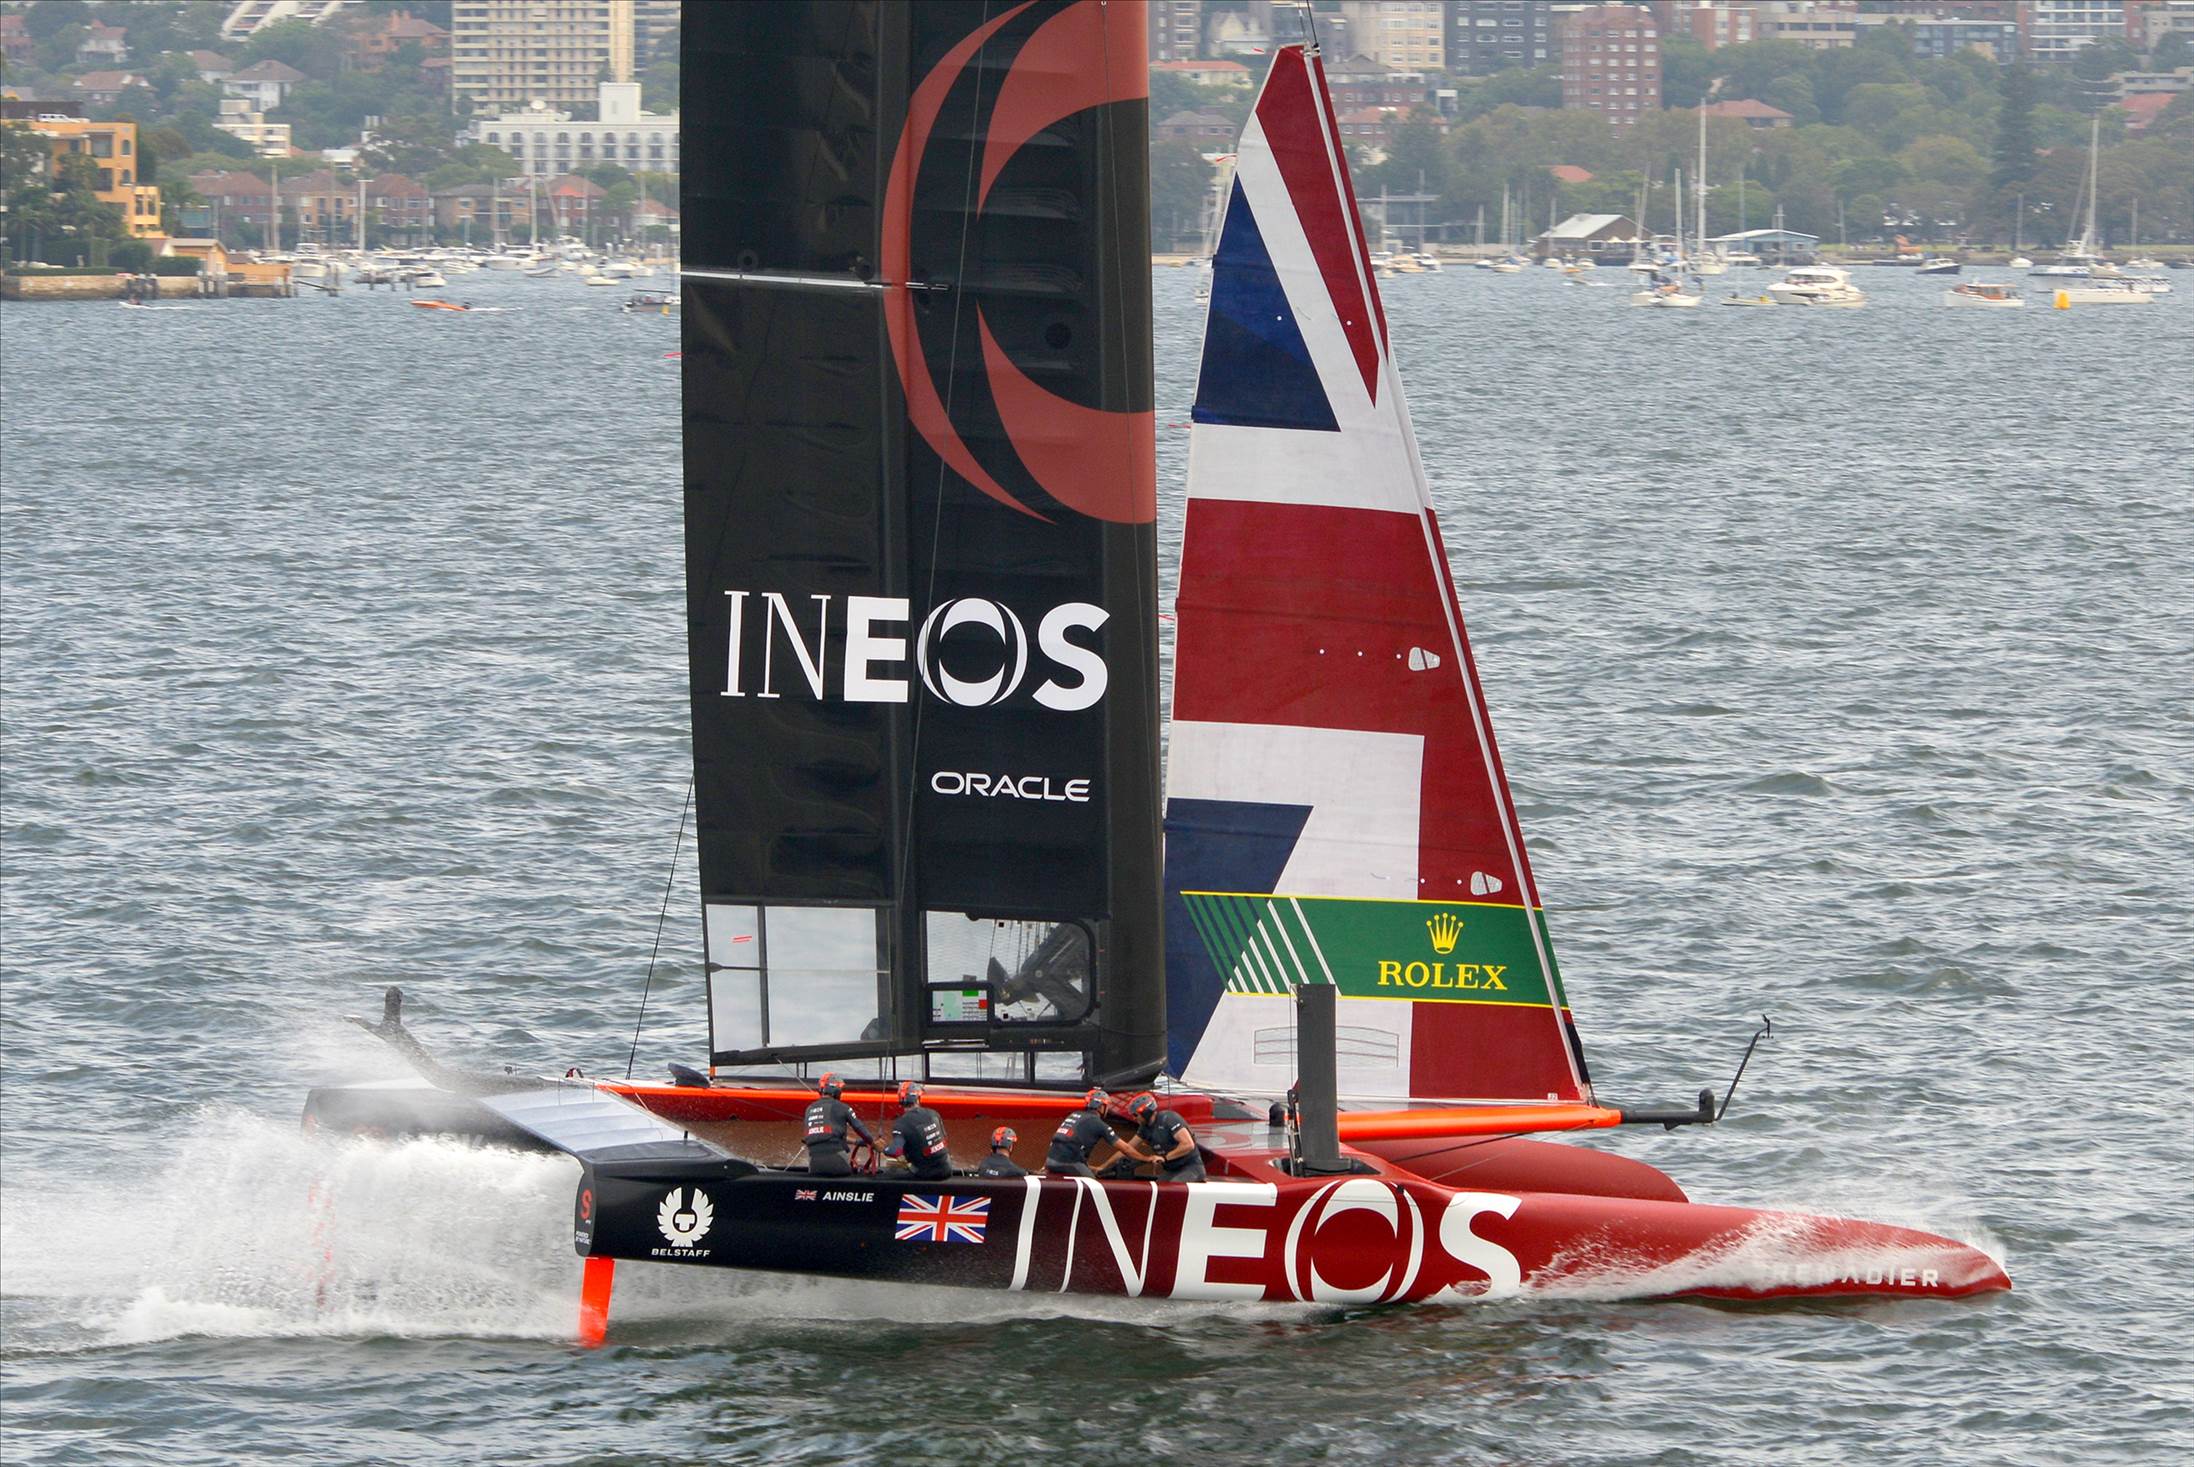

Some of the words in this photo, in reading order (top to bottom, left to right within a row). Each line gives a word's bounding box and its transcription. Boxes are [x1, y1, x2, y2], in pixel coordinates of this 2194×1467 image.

[720, 590, 1111, 712] INEOS
[931, 771, 1091, 802] ORACLE
[1377, 960, 1508, 991] ROLEX
[822, 1191, 875, 1202] AINSLIE
[651, 1247, 711, 1257] BELSTAFF
[1008, 1176, 1522, 1304] INEOS
